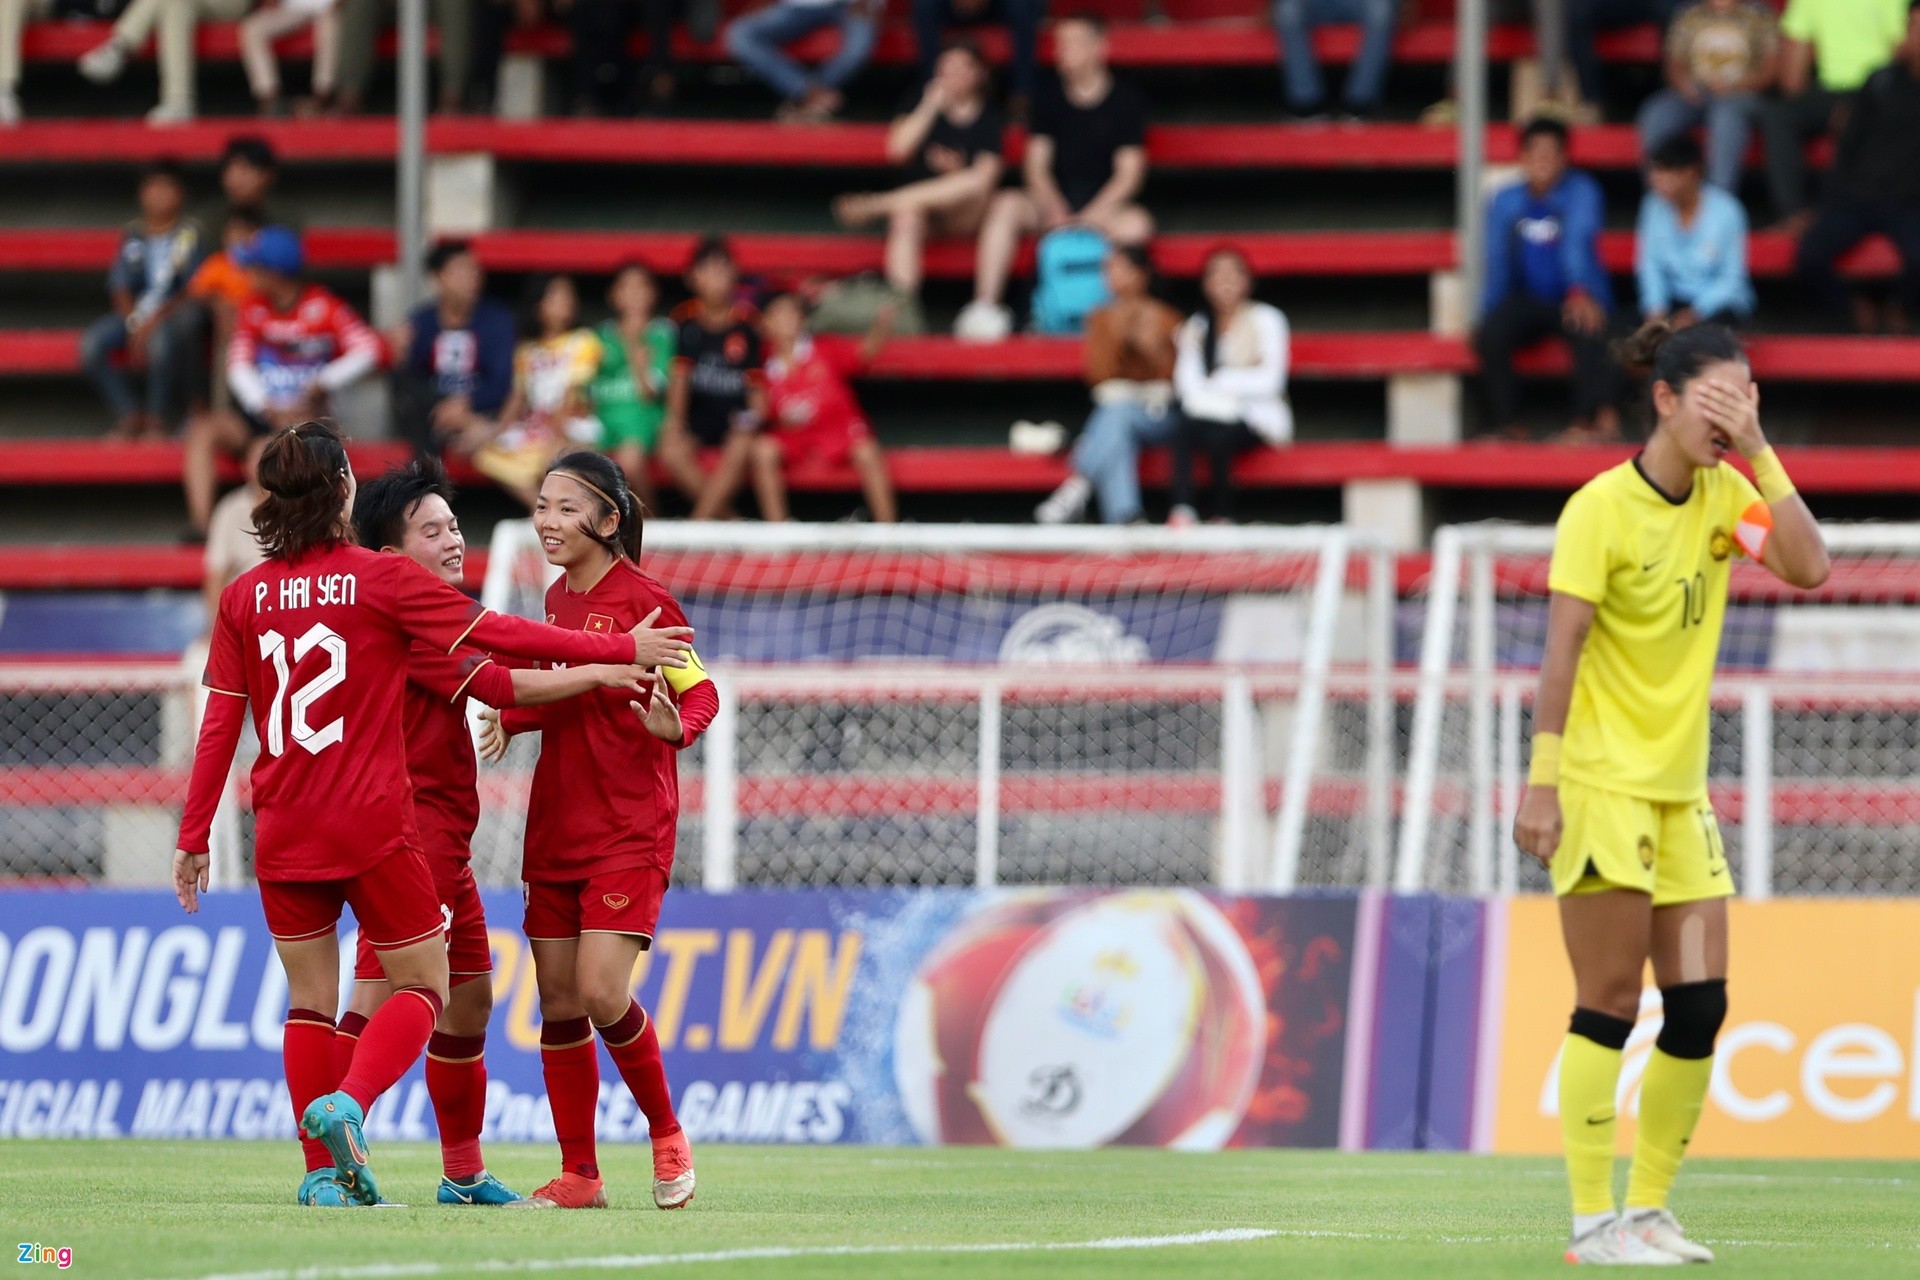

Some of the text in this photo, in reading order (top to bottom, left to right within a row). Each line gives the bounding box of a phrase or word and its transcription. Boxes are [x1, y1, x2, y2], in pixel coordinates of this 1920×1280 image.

[255, 573, 356, 614] P. HAI YEN
[1676, 571, 1706, 630] 10
[258, 621, 346, 758] 12
[677, 1080, 850, 1142] GAMES
